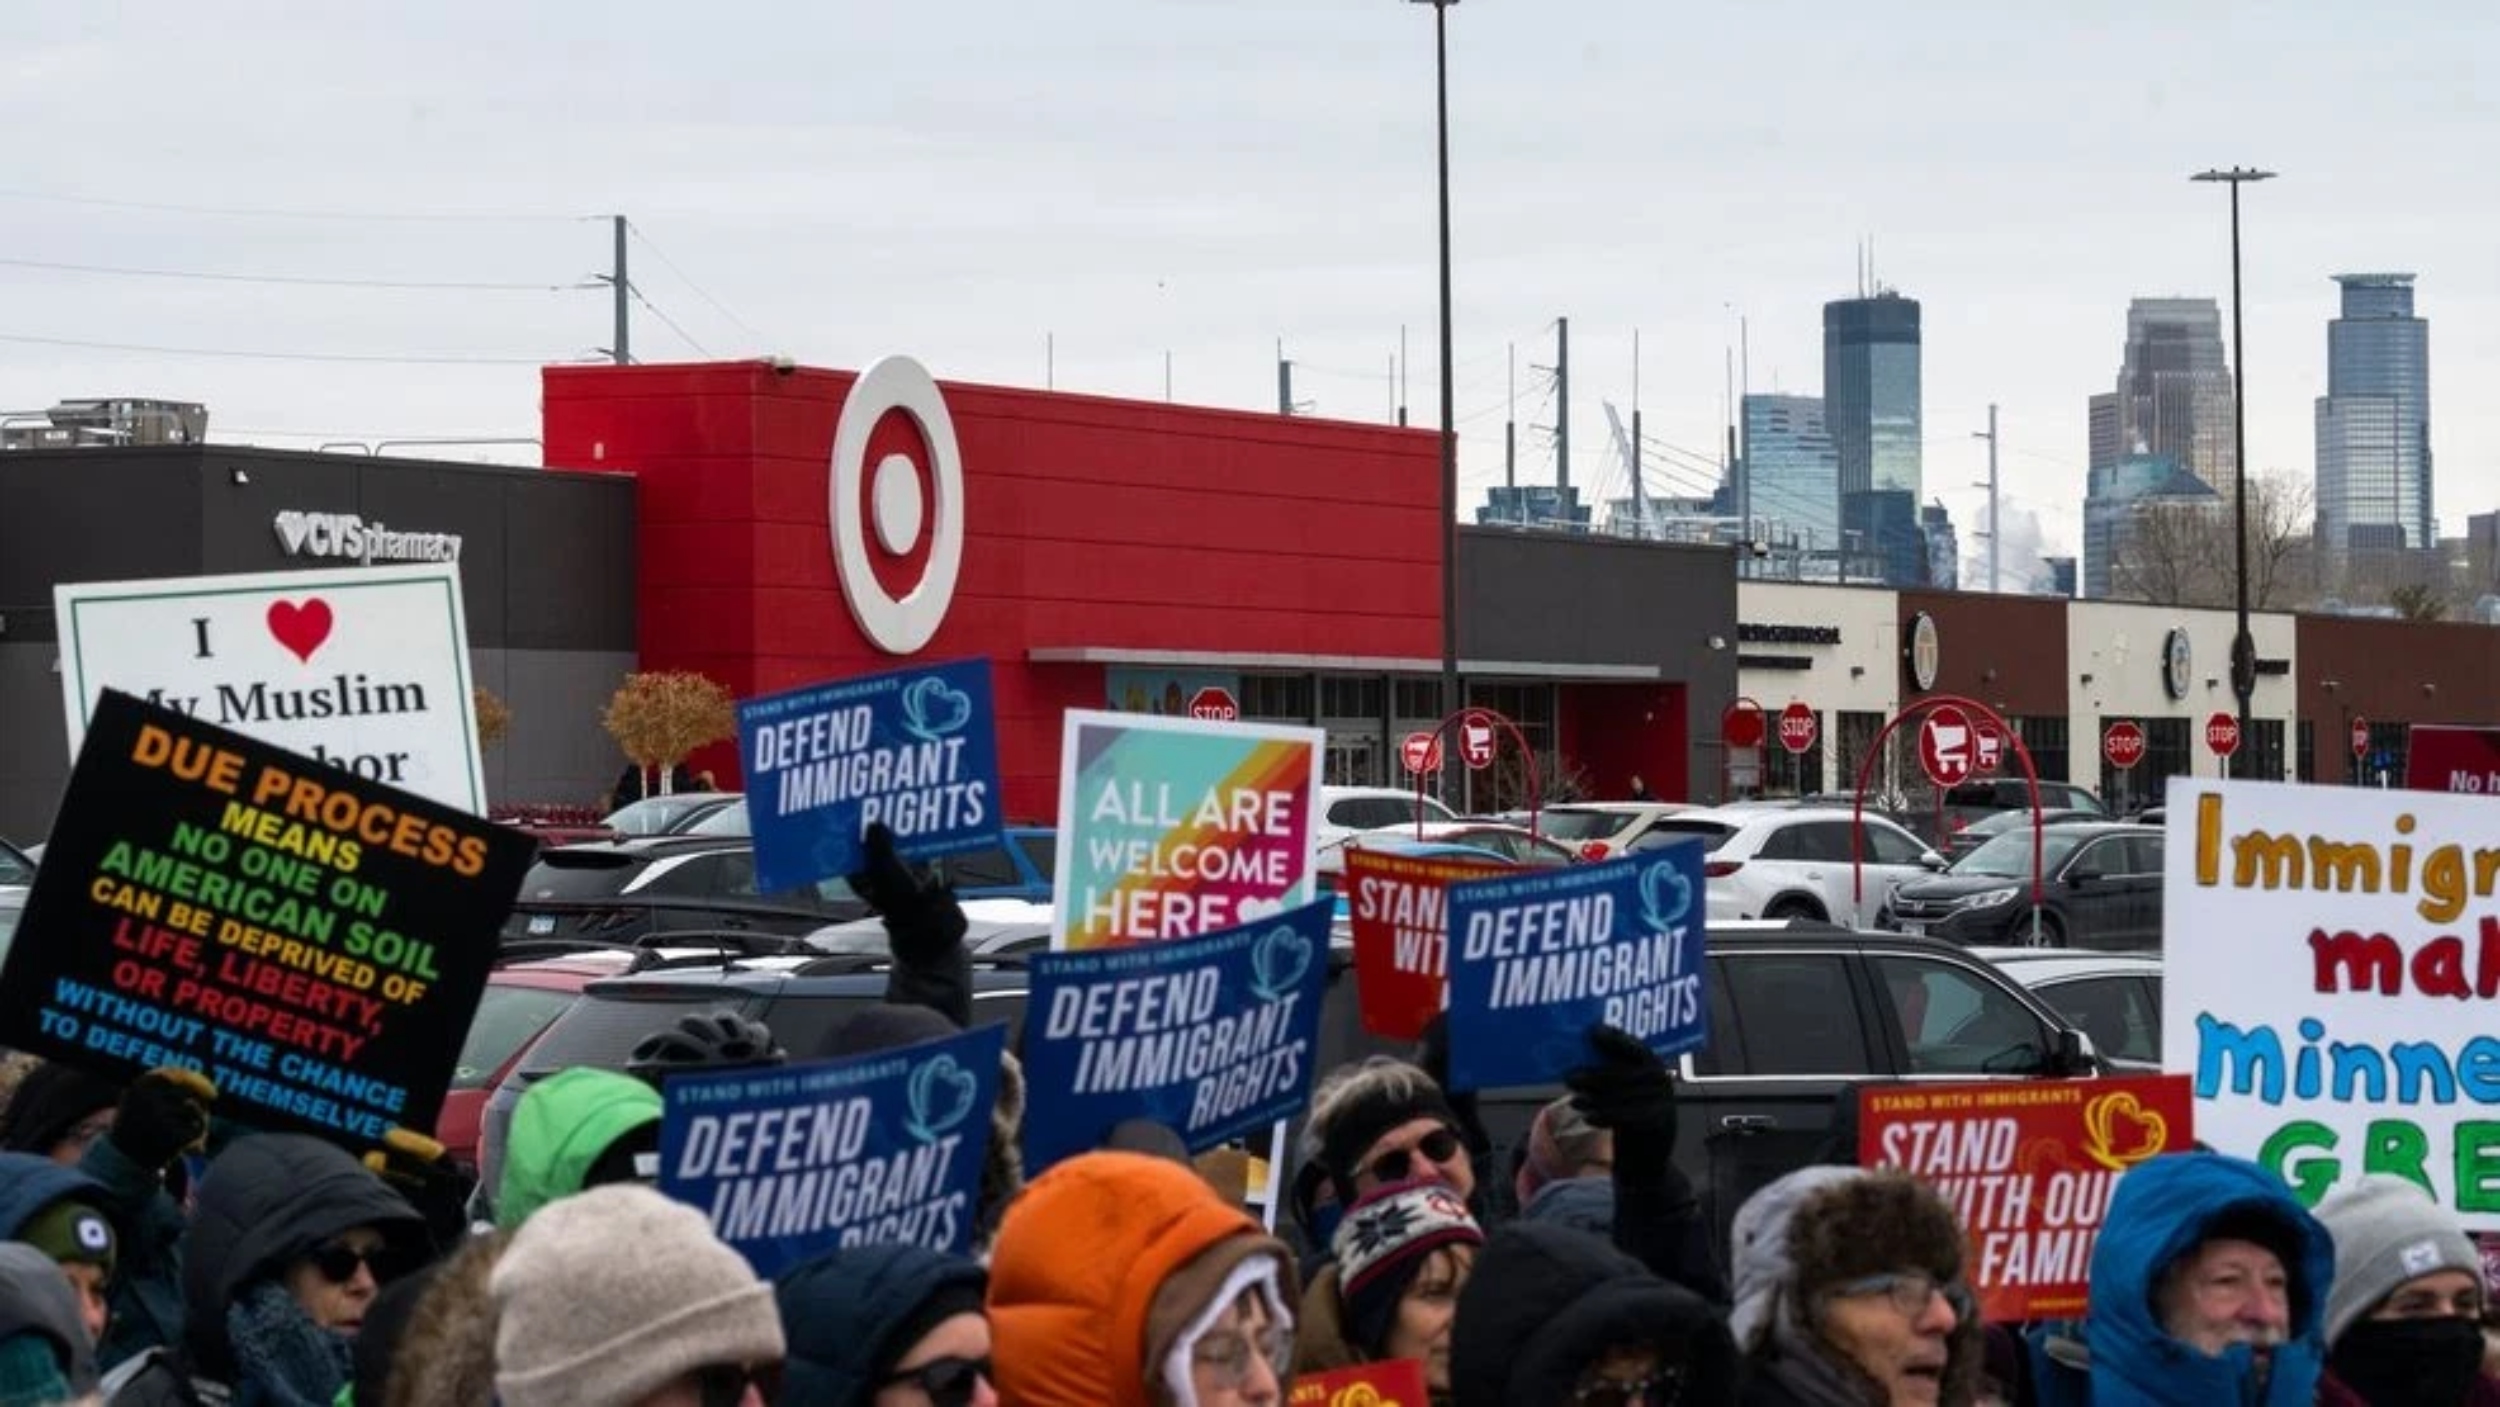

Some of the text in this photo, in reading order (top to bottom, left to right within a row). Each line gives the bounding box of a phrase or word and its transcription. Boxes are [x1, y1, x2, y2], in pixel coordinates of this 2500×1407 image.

[305, 512, 462, 566] CVS pharmacy
[191, 617, 214, 659] I
[216, 673, 428, 724] Muslim
[742, 702, 783, 721] STAND
[818, 678, 900, 704] IMMIGRANTS
[1193, 706, 1234, 722] STOP
[1782, 716, 1815, 737] STOP
[754, 704, 873, 774] DEFEND
[2107, 736, 2140, 753] STOP
[2207, 726, 2237, 743] STOP
[132, 724, 247, 795] DUE
[252, 766, 489, 878] PROCESS
[777, 736, 966, 817] IMMIGRANT
[1091, 778, 1294, 837] ALL ARE
[2451, 769, 2480, 792] No
[220, 800, 363, 873] MEANS
[859, 780, 986, 843] RIGHTS
[171, 821, 388, 918] NO ONE ON
[1088, 835, 1291, 886] WELCOME
[1456, 863, 1637, 902] STAND WITH IMMIGRANTS
[2195, 792, 2500, 924] Immigr
[91, 876, 428, 1006] CAN BE DEPRIVED OF
[99, 840, 440, 981] AMERICAN SOIL
[1083, 886, 1232, 939] HERE
[1464, 893, 1615, 962] DEFEND
[112, 917, 384, 1037] LIFE, LIBERTY,
[1041, 958, 1098, 976] STAND
[1104, 952, 1150, 971] WITH
[1394, 927, 1448, 977] WIT
[1488, 926, 1687, 1010] IMMIGRANT
[2306, 915, 2500, 1002] mak
[112, 959, 366, 1061] OR PROPERTY
[1045, 965, 1221, 1040] DEFEND
[1603, 974, 1700, 1039] RIGHTS
[39, 1007, 80, 1040] TO
[85, 1024, 202, 1074] DEFEND
[54, 978, 410, 1113] WITHOUT THE CHANCE
[1073, 991, 1301, 1094] IMMIGRANT
[677, 1058, 909, 1105] STAND WITH IMMIGRANTS
[1187, 1038, 1307, 1132] RIGHTS
[1872, 1087, 2083, 1113] STAND WITH IMMIGRANTS
[676, 1096, 873, 1180] DEFEND
[1876, 1116, 2019, 1176] STAND
[2258, 1118, 2500, 1213] GRE
[709, 1132, 963, 1241] IMMIGRANT
[1977, 1228, 2101, 1289] FAMI
